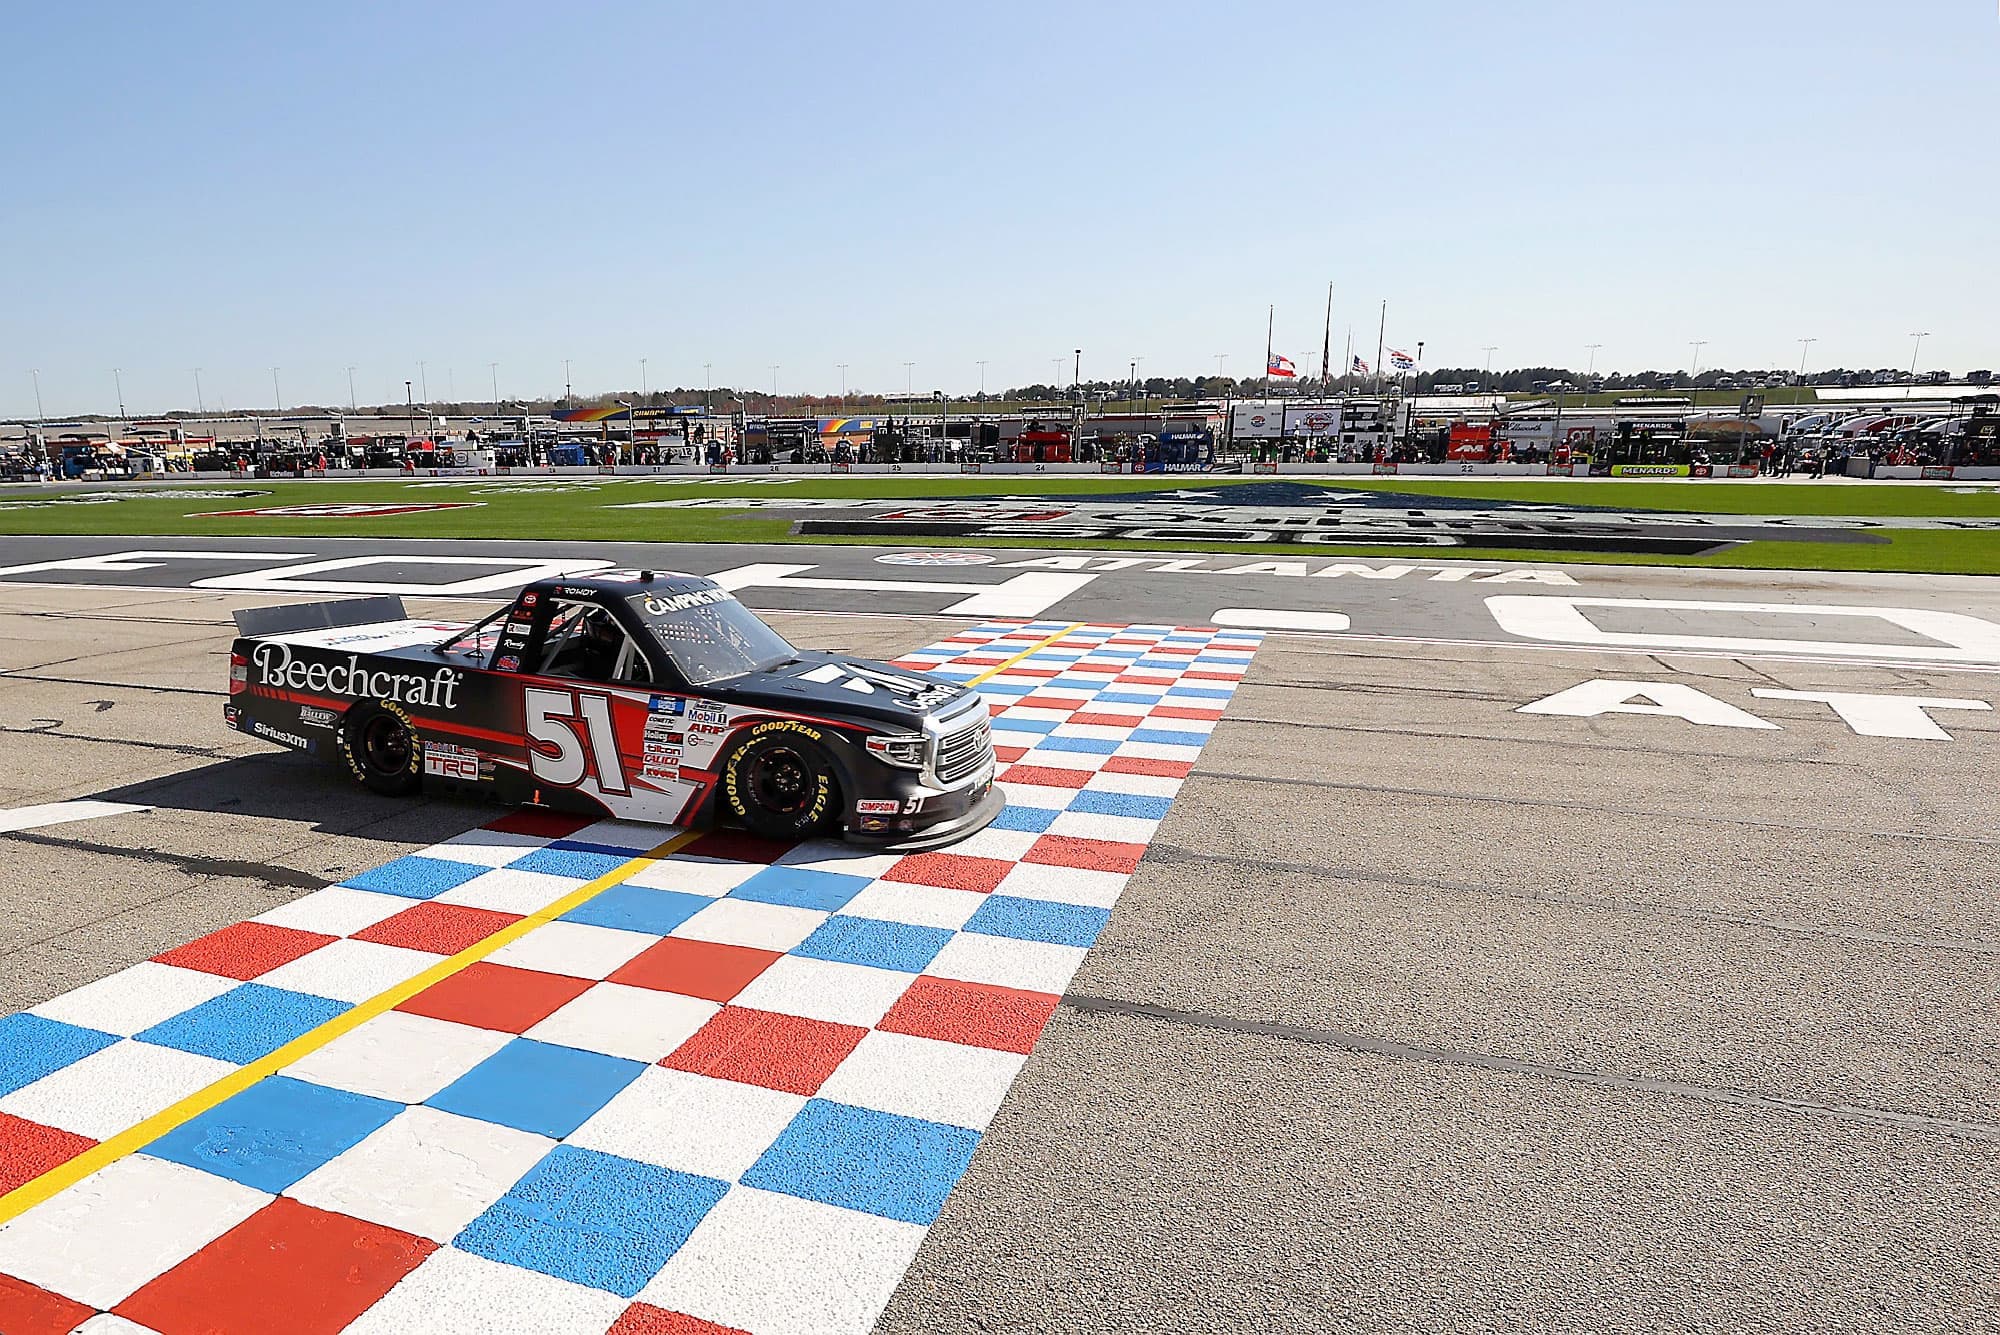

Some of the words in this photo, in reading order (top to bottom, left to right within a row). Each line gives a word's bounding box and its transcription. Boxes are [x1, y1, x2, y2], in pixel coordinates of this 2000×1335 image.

[1035, 464, 1046, 472] 24
[1163, 463, 1201, 472] HALMAR
[1460, 465, 1474, 473] 22
[1622, 467, 1678, 475] MENARDS
[961, 525, 1467, 546] 500
[986, 555, 1582, 587] ATLANTA
[564, 587, 598, 596] ROWDY
[645, 589, 712, 616] CAMPING
[252, 641, 461, 709] Beechcraft
[688, 710, 716, 722] Mobil
[1516, 678, 1991, 741] AT
[645, 729, 667, 742] Holley
[688, 723, 725, 735] ARP
[752, 719, 822, 741] GOODYEAR
[526, 686, 630, 795] 51
[647, 743, 681, 756] tilton
[426, 756, 477, 778] TRD
[645, 755, 679, 766] CALICO
[808, 774, 829, 823] EAGLE
[860, 801, 896, 812] SIMPSON
[902, 796, 925, 815] 51
